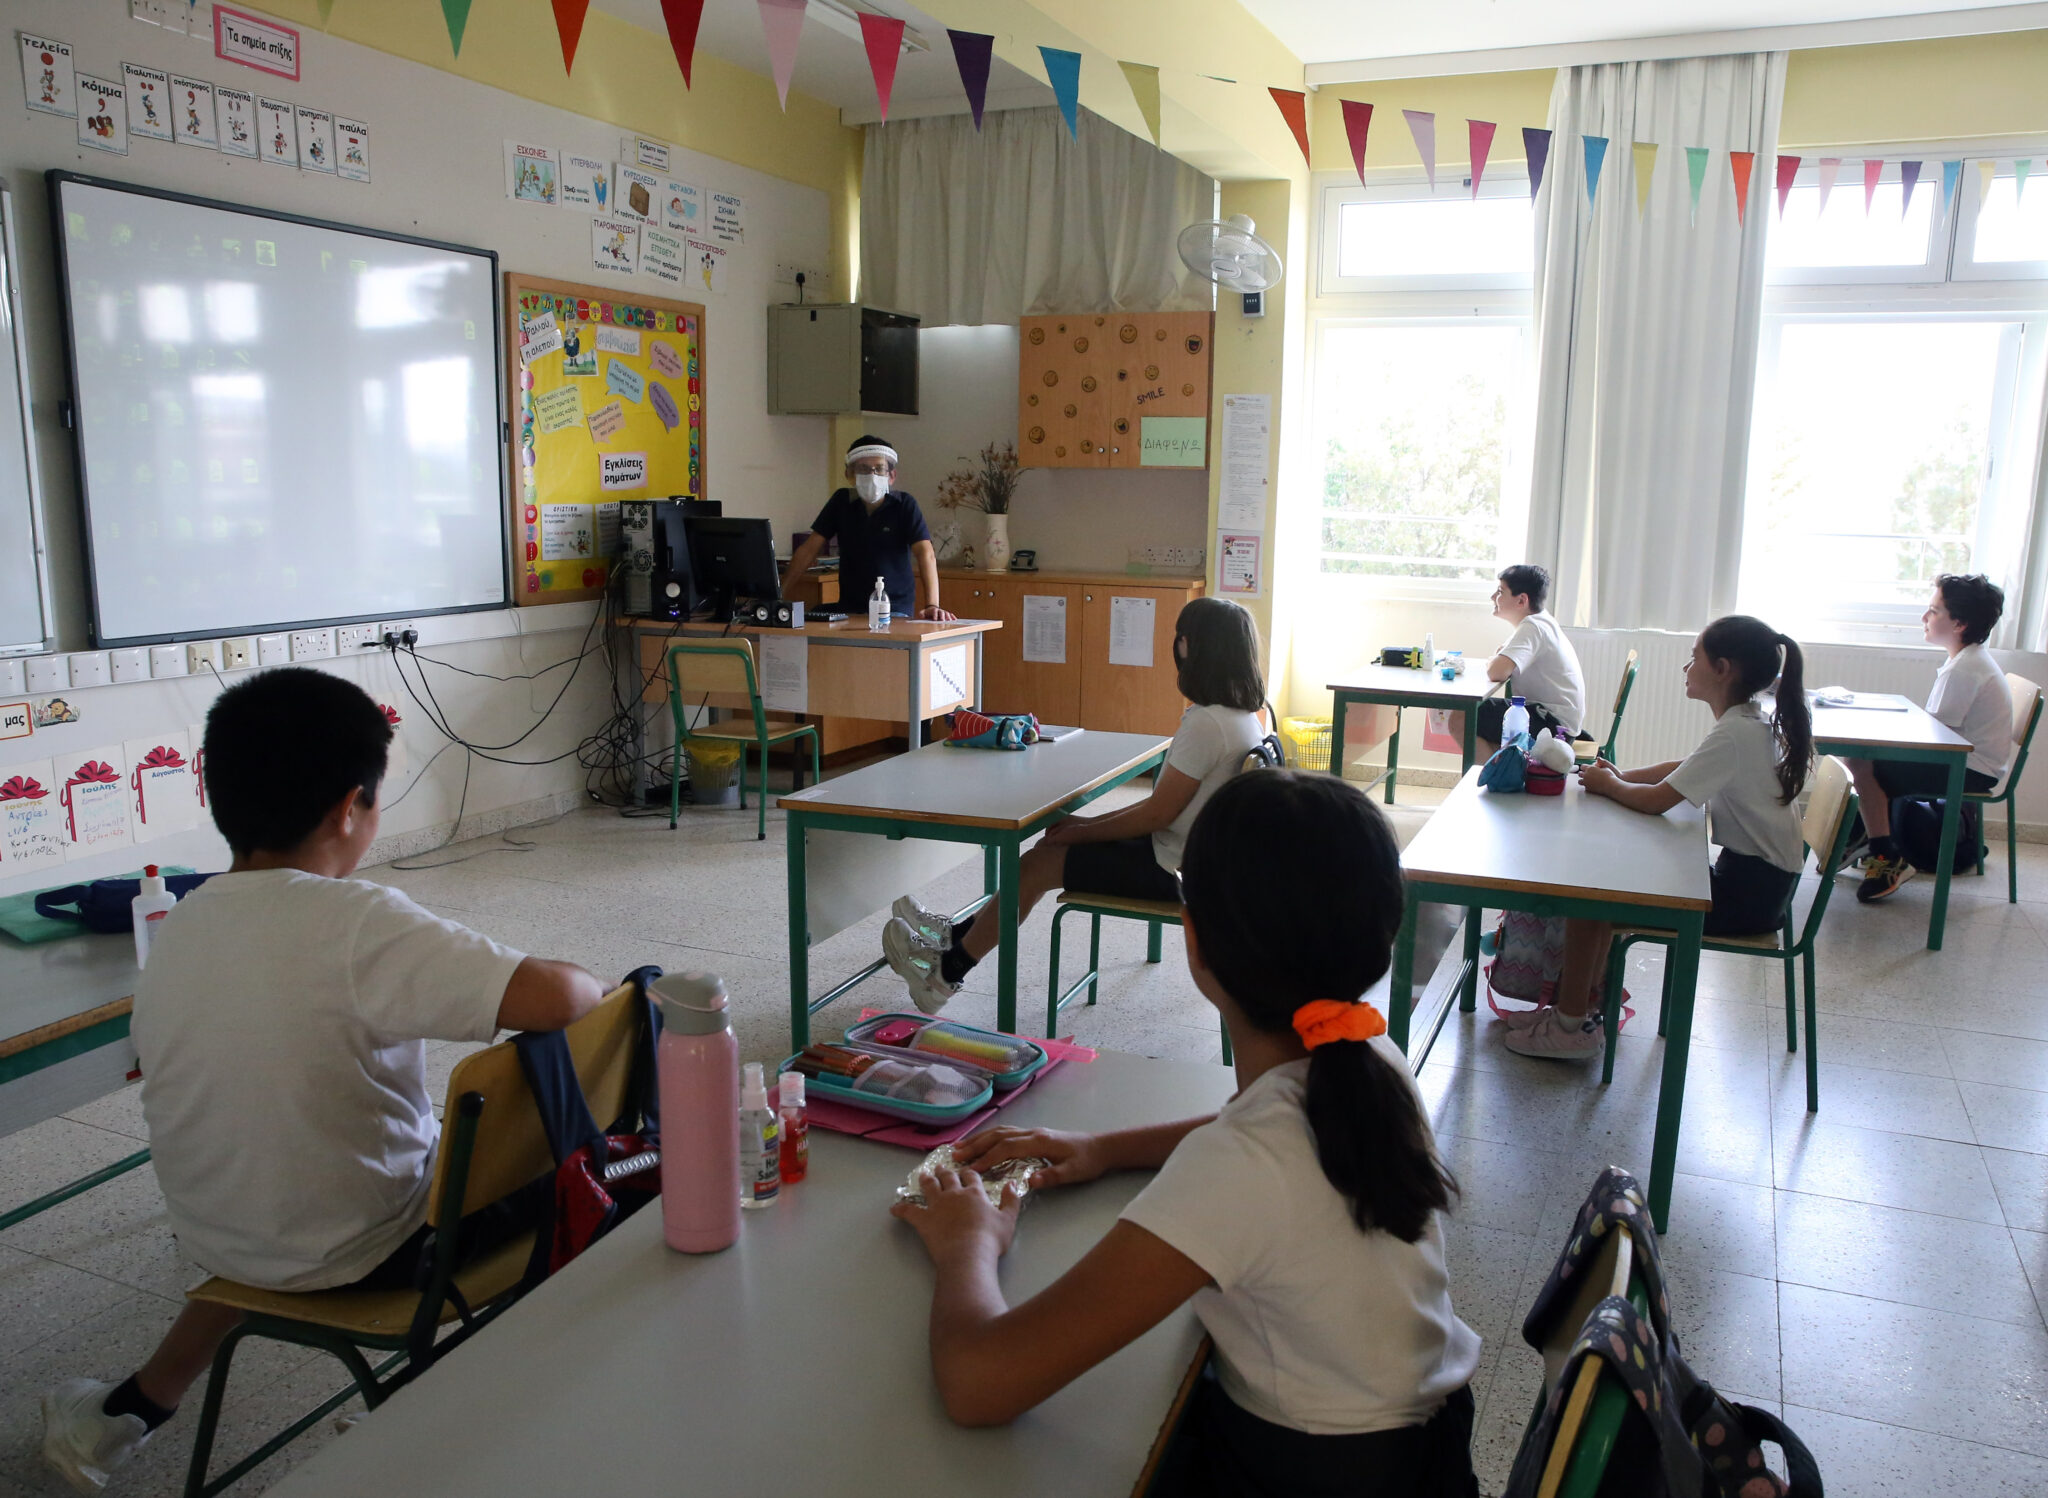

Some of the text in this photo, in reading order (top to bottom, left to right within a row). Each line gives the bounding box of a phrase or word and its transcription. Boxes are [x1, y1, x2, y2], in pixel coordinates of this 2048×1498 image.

[22, 37, 70, 56] τελεία
[227, 26, 292, 61] Τα σημεία στίξης
[125, 65, 165, 82] διαλυτικά
[81, 80, 123, 98] κόμμα
[173, 78, 210, 93] απόστροφος
[218, 88, 251, 102] εισαγωγικά
[260, 98, 290, 114] θαυμαστικό
[338, 123, 367, 136] παύλα
[516, 144, 548, 159] ΕΙΚΟΝΕΣ
[570, 156, 603, 171] ΥΠΕΡΒΟΛΗ
[623, 168, 657, 187] ΚΥΡΙΟΛΕΞΙΑ
[593, 219, 636, 235] ΠΑΡΟΜΟΙΩΣΗ
[647, 231, 681, 249] ΚΟΣΜΗΤΙΚΑ
[651, 243, 676, 259] ΕΠΙΘΕΤΑ
[531, 337, 555, 356] αλεπού
[1137, 386, 1166, 405] SMILE
[604, 457, 643, 472] Εγκλίσεις
[604, 472, 642, 485] ρημάτων
[4, 714, 25, 728] μας
